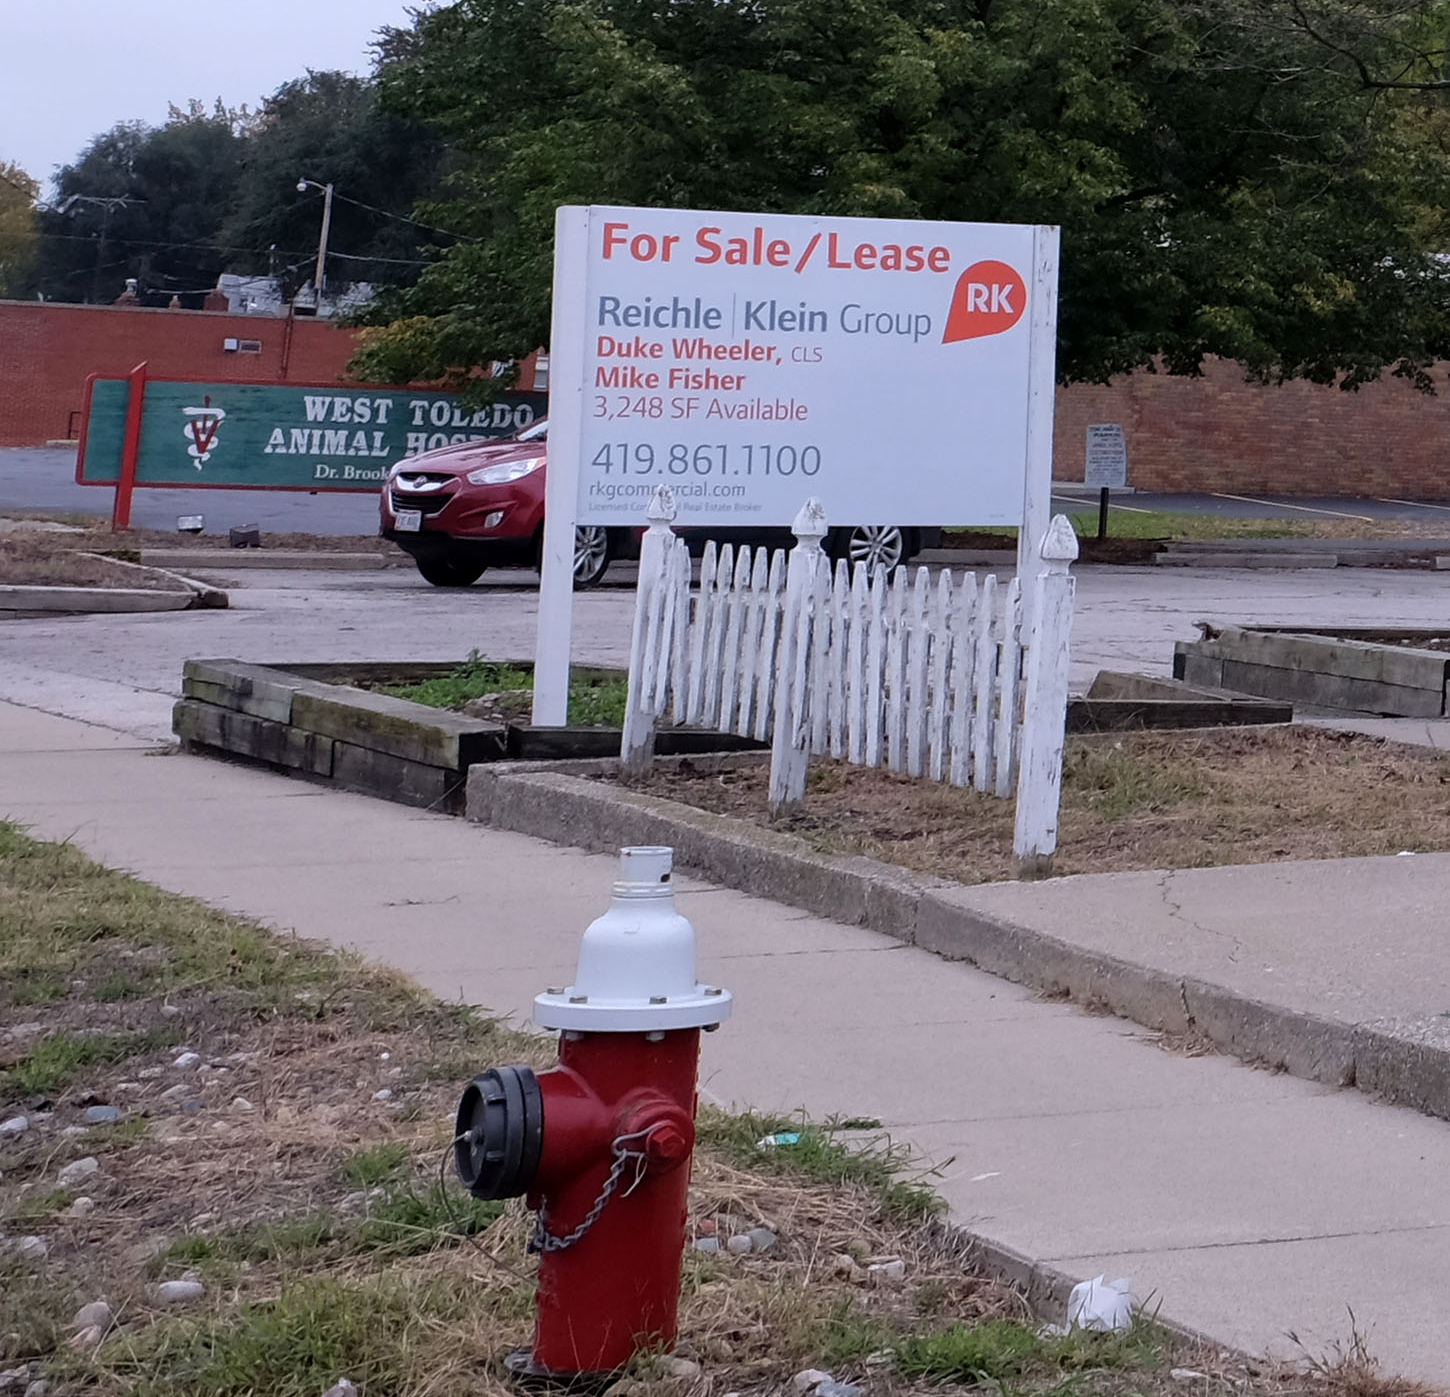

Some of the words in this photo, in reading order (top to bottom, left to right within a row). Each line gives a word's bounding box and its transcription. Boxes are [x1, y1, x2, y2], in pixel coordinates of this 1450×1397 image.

[602, 221, 680, 263] For
[966, 282, 1014, 314] RK
[598, 295, 723, 330] Reichle
[744, 299, 828, 333] Klein
[840, 303, 932, 343] Group
[597, 335, 664, 359] Duke
[672, 338, 783, 366] Wheeler,
[791, 346, 824, 363] CLS
[595, 365, 660, 389] Mike
[668, 367, 747, 391] Fisher
[303, 395, 393, 425] WEST
[409, 399, 535, 429] TOLEDO
[593, 395, 664, 422] 3,248
[671, 397, 700, 419] SF
[706, 397, 809, 421] Available
[263, 427, 391, 457] ANIMAL
[313, 463, 339, 479] Dr.
[591, 442, 822, 477] 419.861.1100
